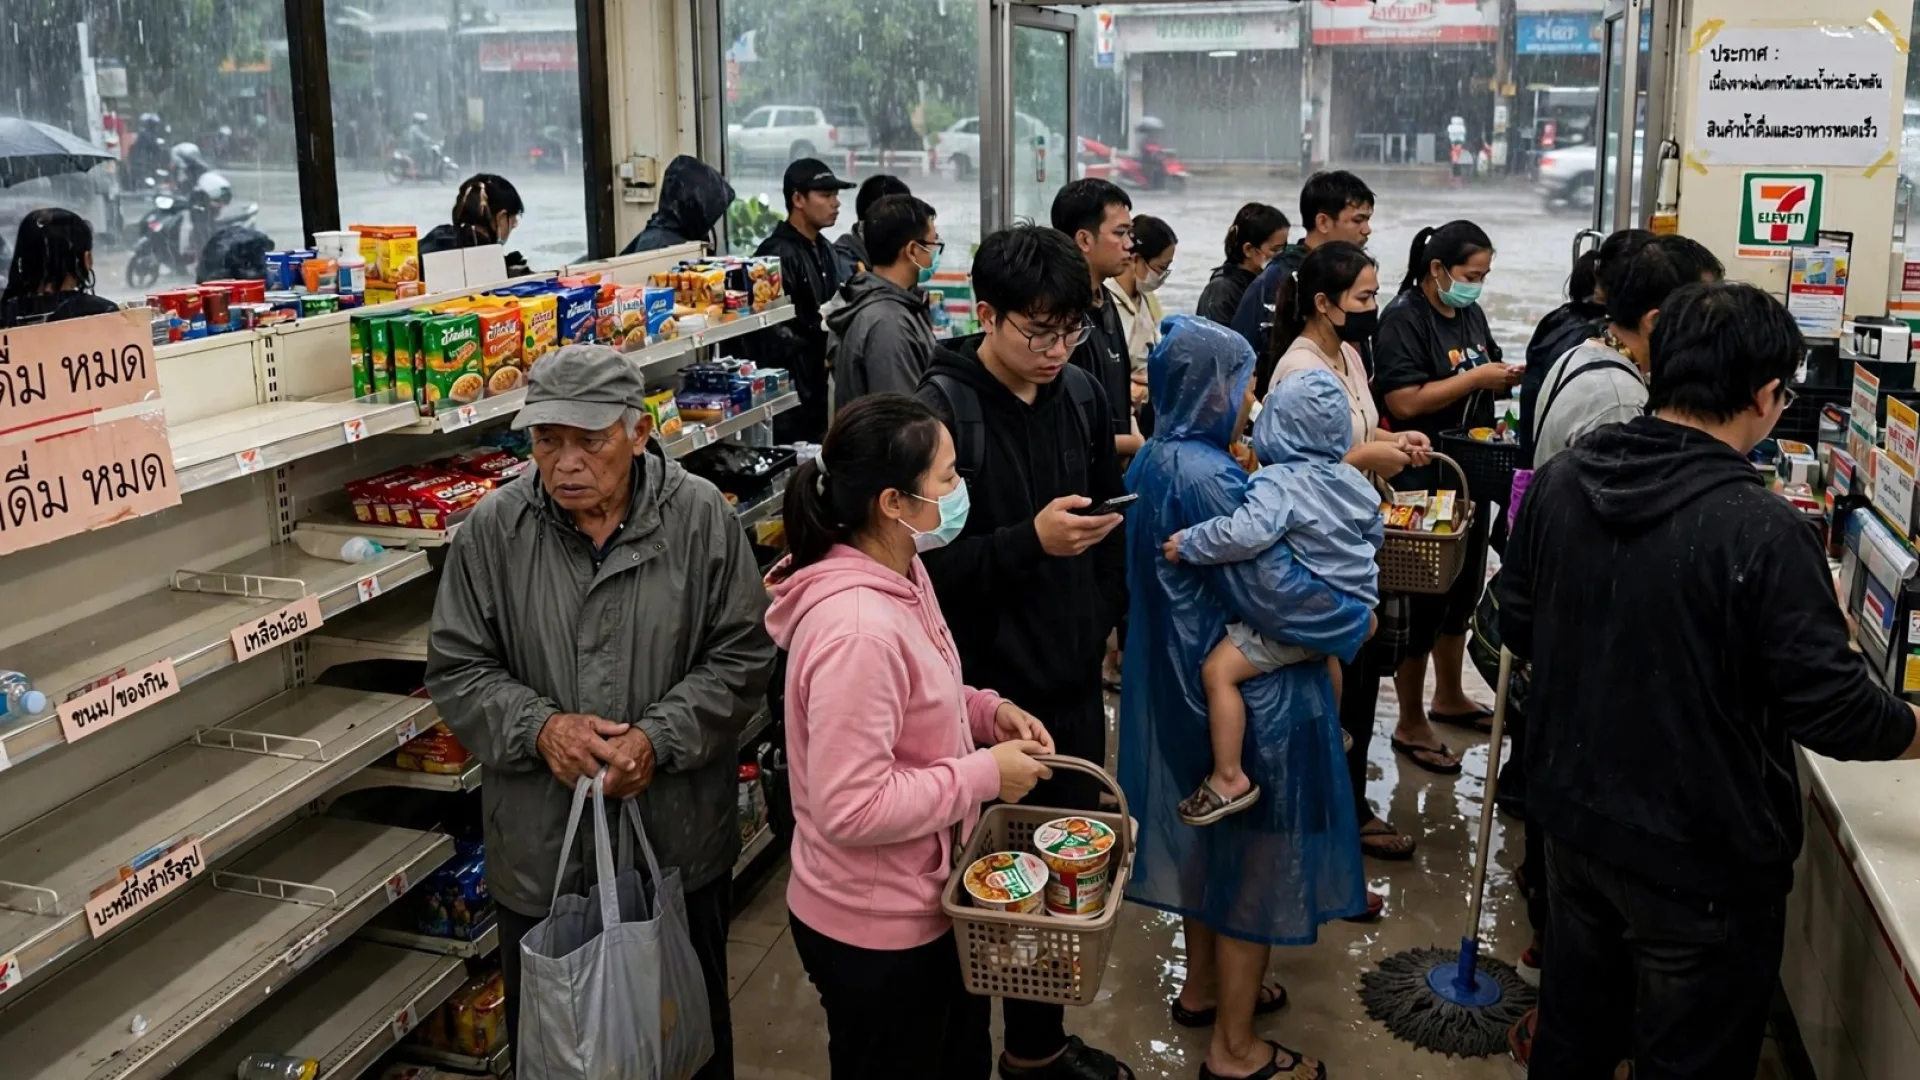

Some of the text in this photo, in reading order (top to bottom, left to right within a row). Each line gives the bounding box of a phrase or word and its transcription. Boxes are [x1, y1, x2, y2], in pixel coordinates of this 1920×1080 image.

[1710, 43, 1769, 62] ประกาศ
[61, 343, 146, 393] หมด
[82, 452, 167, 506] หมด
[71, 671, 169, 728] ขนม/ของกิน
